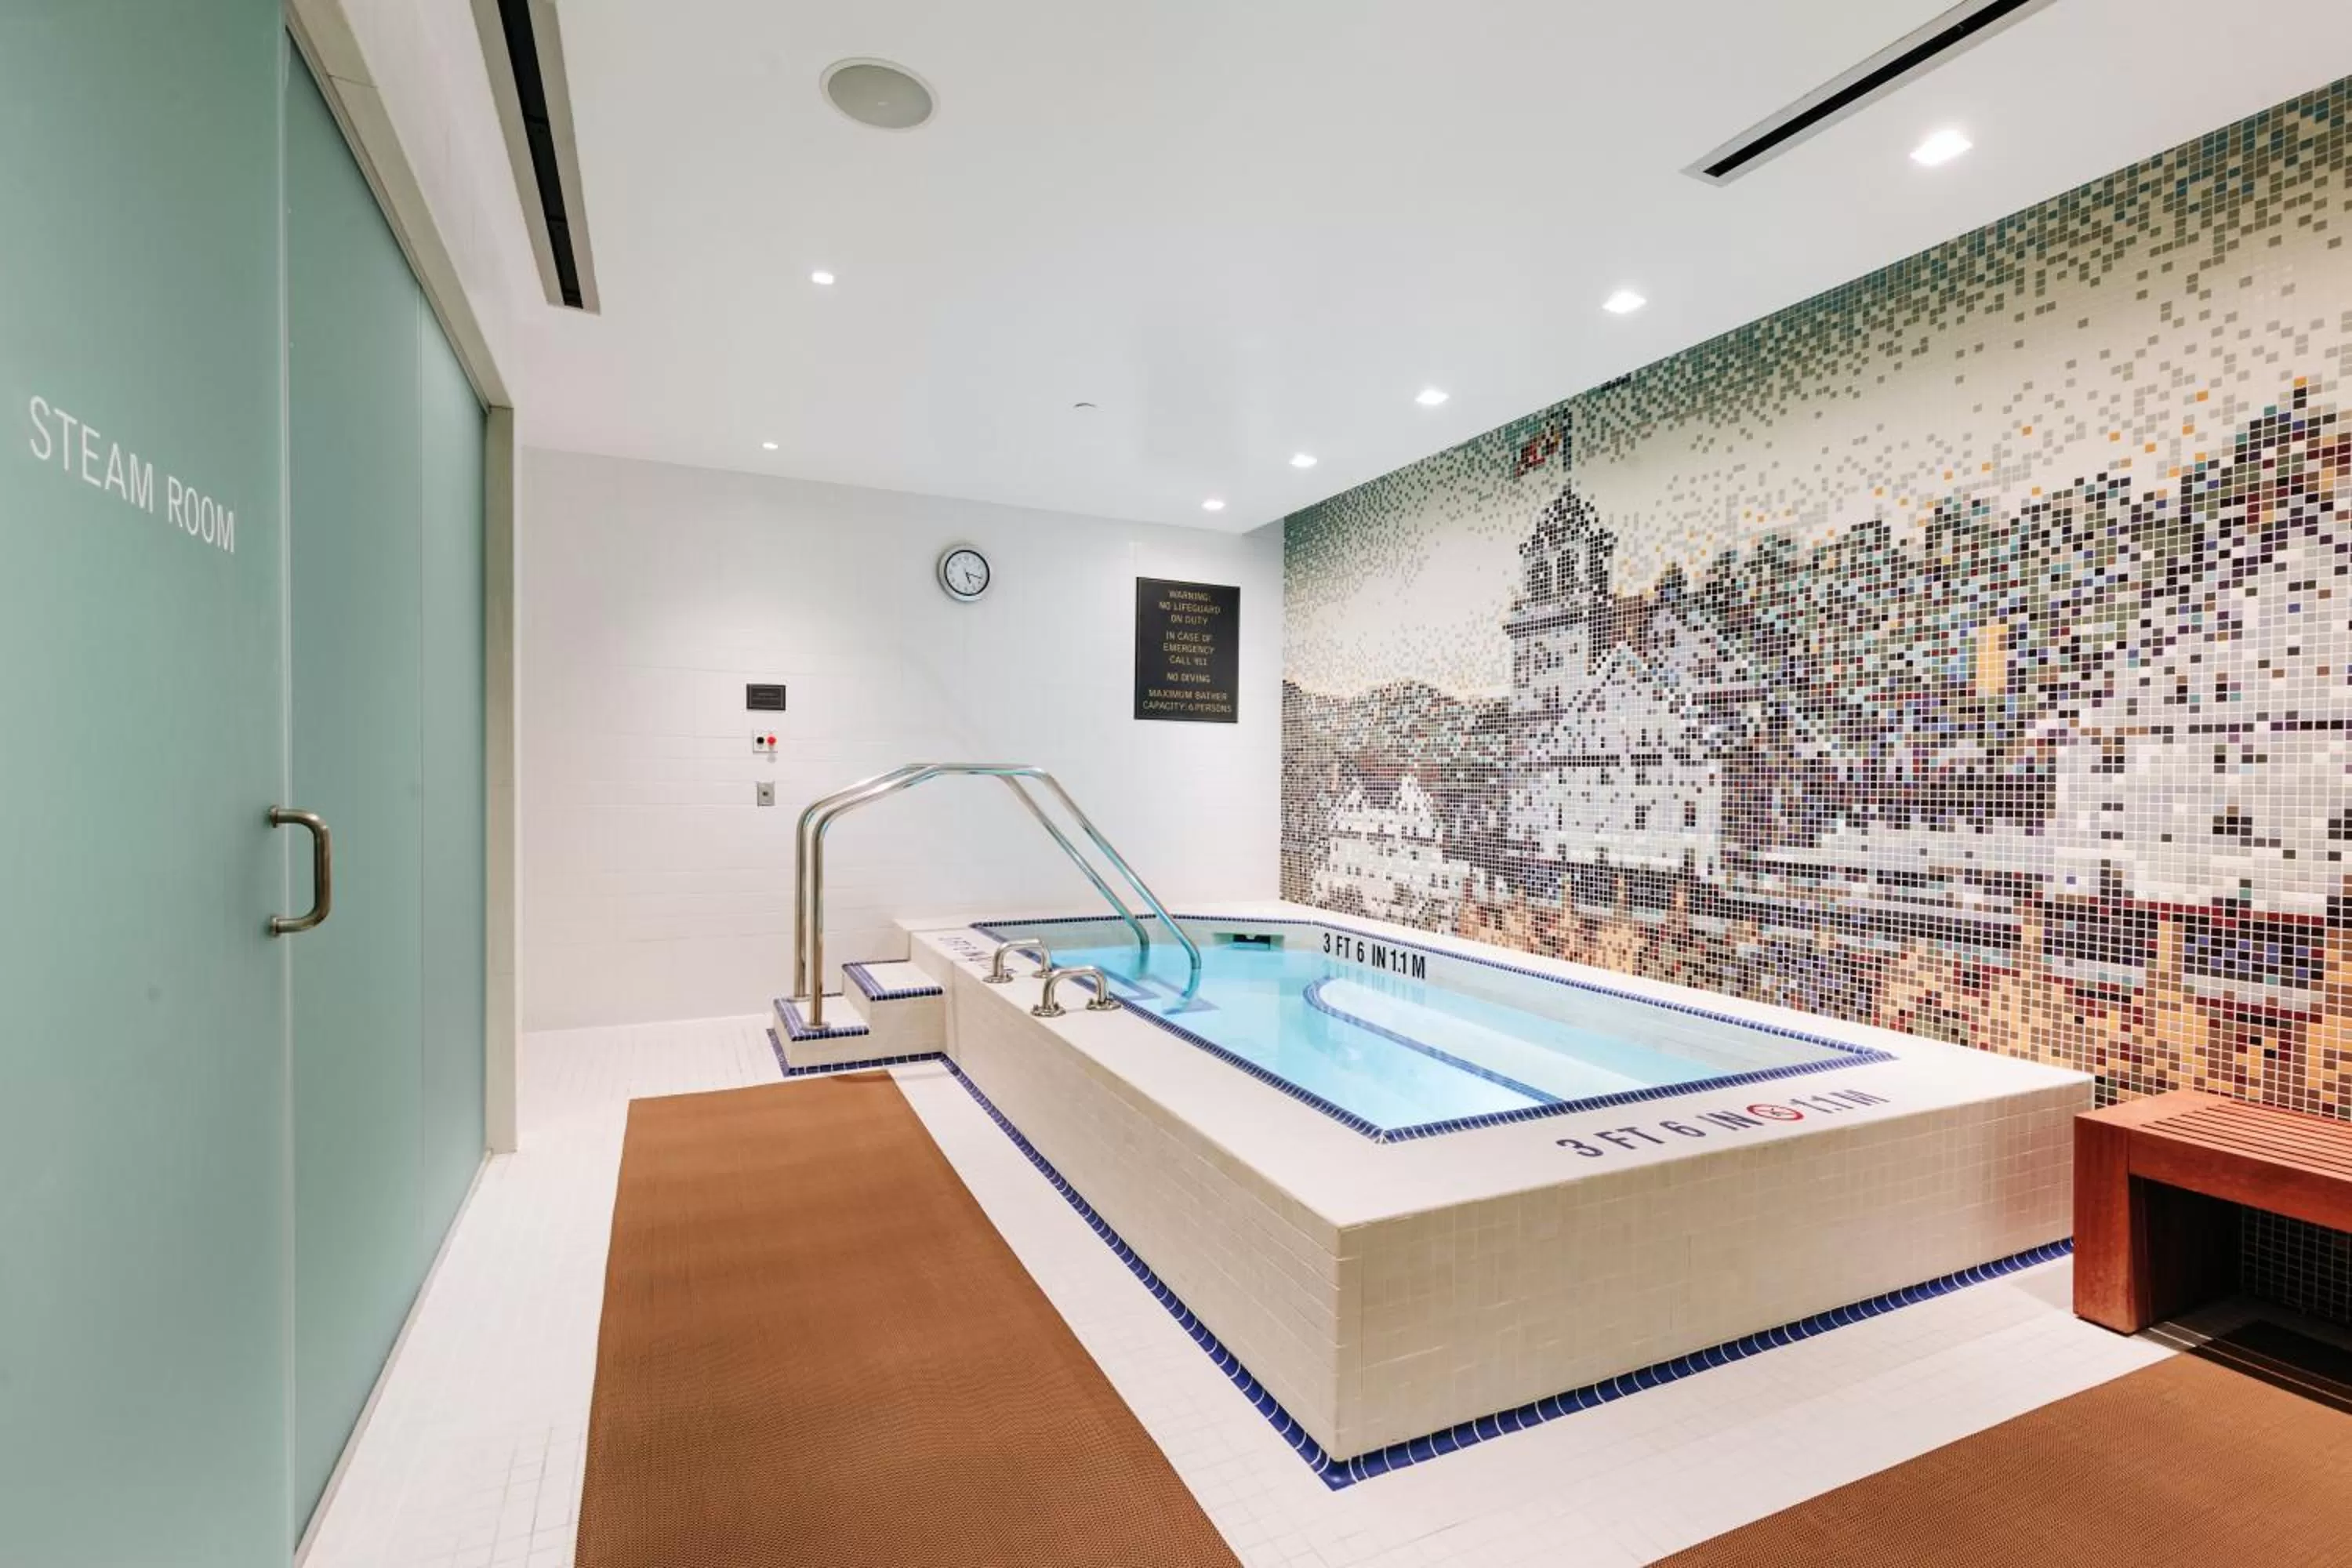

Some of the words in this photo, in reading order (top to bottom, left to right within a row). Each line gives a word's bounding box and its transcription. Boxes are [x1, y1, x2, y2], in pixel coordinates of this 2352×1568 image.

[29, 395, 153, 514] STEAM
[168, 475, 234, 554] ROOM
[1168, 590, 1211, 601] WARNING:
[1158, 601, 1171, 611] NO
[1174, 602, 1221, 615] LIFEGUARD
[1171, 614, 1183, 623] ON
[1185, 615, 1208, 625] DUTY
[1166, 630, 1175, 640] IN
[1177, 631, 1200, 642] CASE
[1163, 642, 1215, 654] EMERGENCY
[1169, 655, 1191, 665] CALL
[1192, 657, 1207, 666] 911
[1167, 672, 1178, 681] NO
[1181, 673, 1211, 683] DIVING
[1149, 689, 1192, 699] MAXIMUM
[1194, 691, 1227, 700] BATHER
[1194, 704, 1232, 713] PERSONS
[1323, 932, 1330, 953] 3
[1336, 935, 1351, 959] FT
[1357, 941, 1365, 963] 6
[1372, 943, 1386, 969] IN
[1390, 949, 1407, 975] 1.1
[1412, 954, 1425, 979] M
[1555, 1138, 1604, 1158] 3
[1593, 1127, 1666, 1150] FT
[1659, 1120, 1707, 1138] 6
[1697, 1110, 1765, 1131] IN
[1790, 1094, 1855, 1114] 1.1
[1831, 1089, 1890, 1104] M
